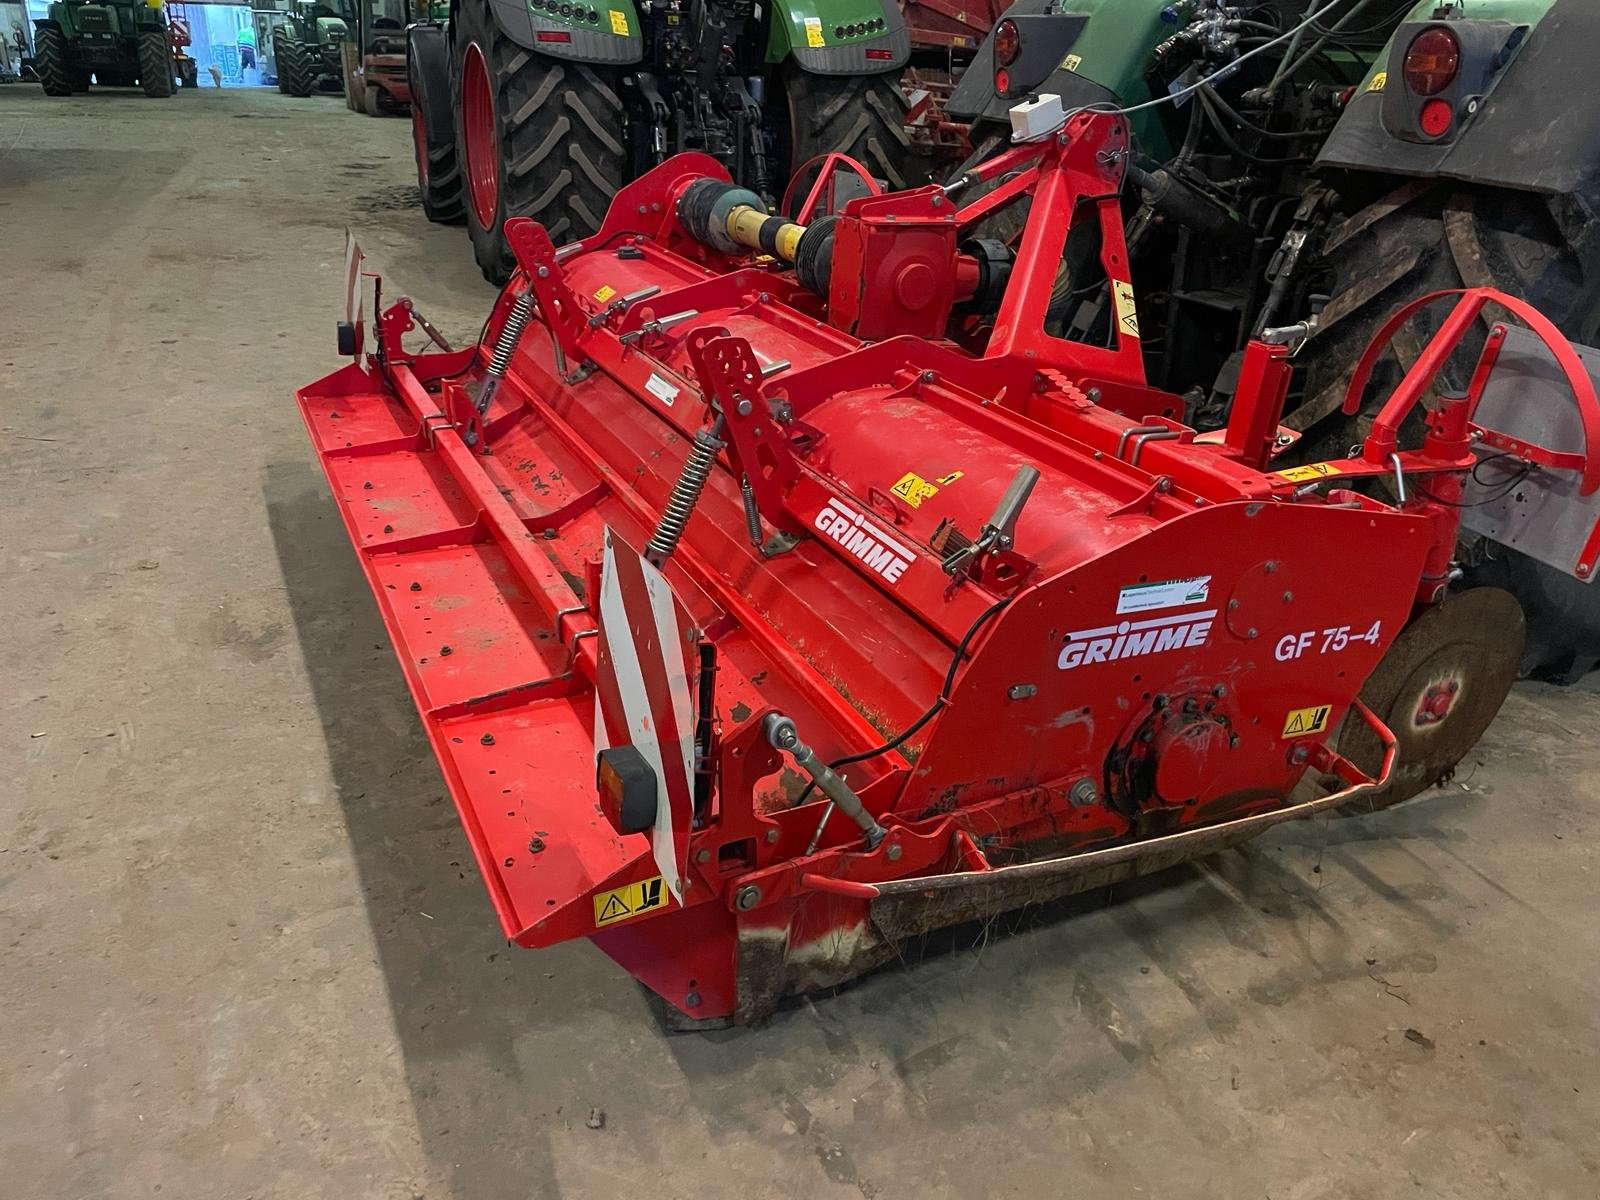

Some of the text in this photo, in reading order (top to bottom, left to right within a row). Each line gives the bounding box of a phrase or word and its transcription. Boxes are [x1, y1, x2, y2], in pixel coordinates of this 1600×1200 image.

[815, 507, 909, 584] GRIMME
[1057, 620, 1213, 670] GRIMME
[1274, 620, 1381, 662] GF 75-4
